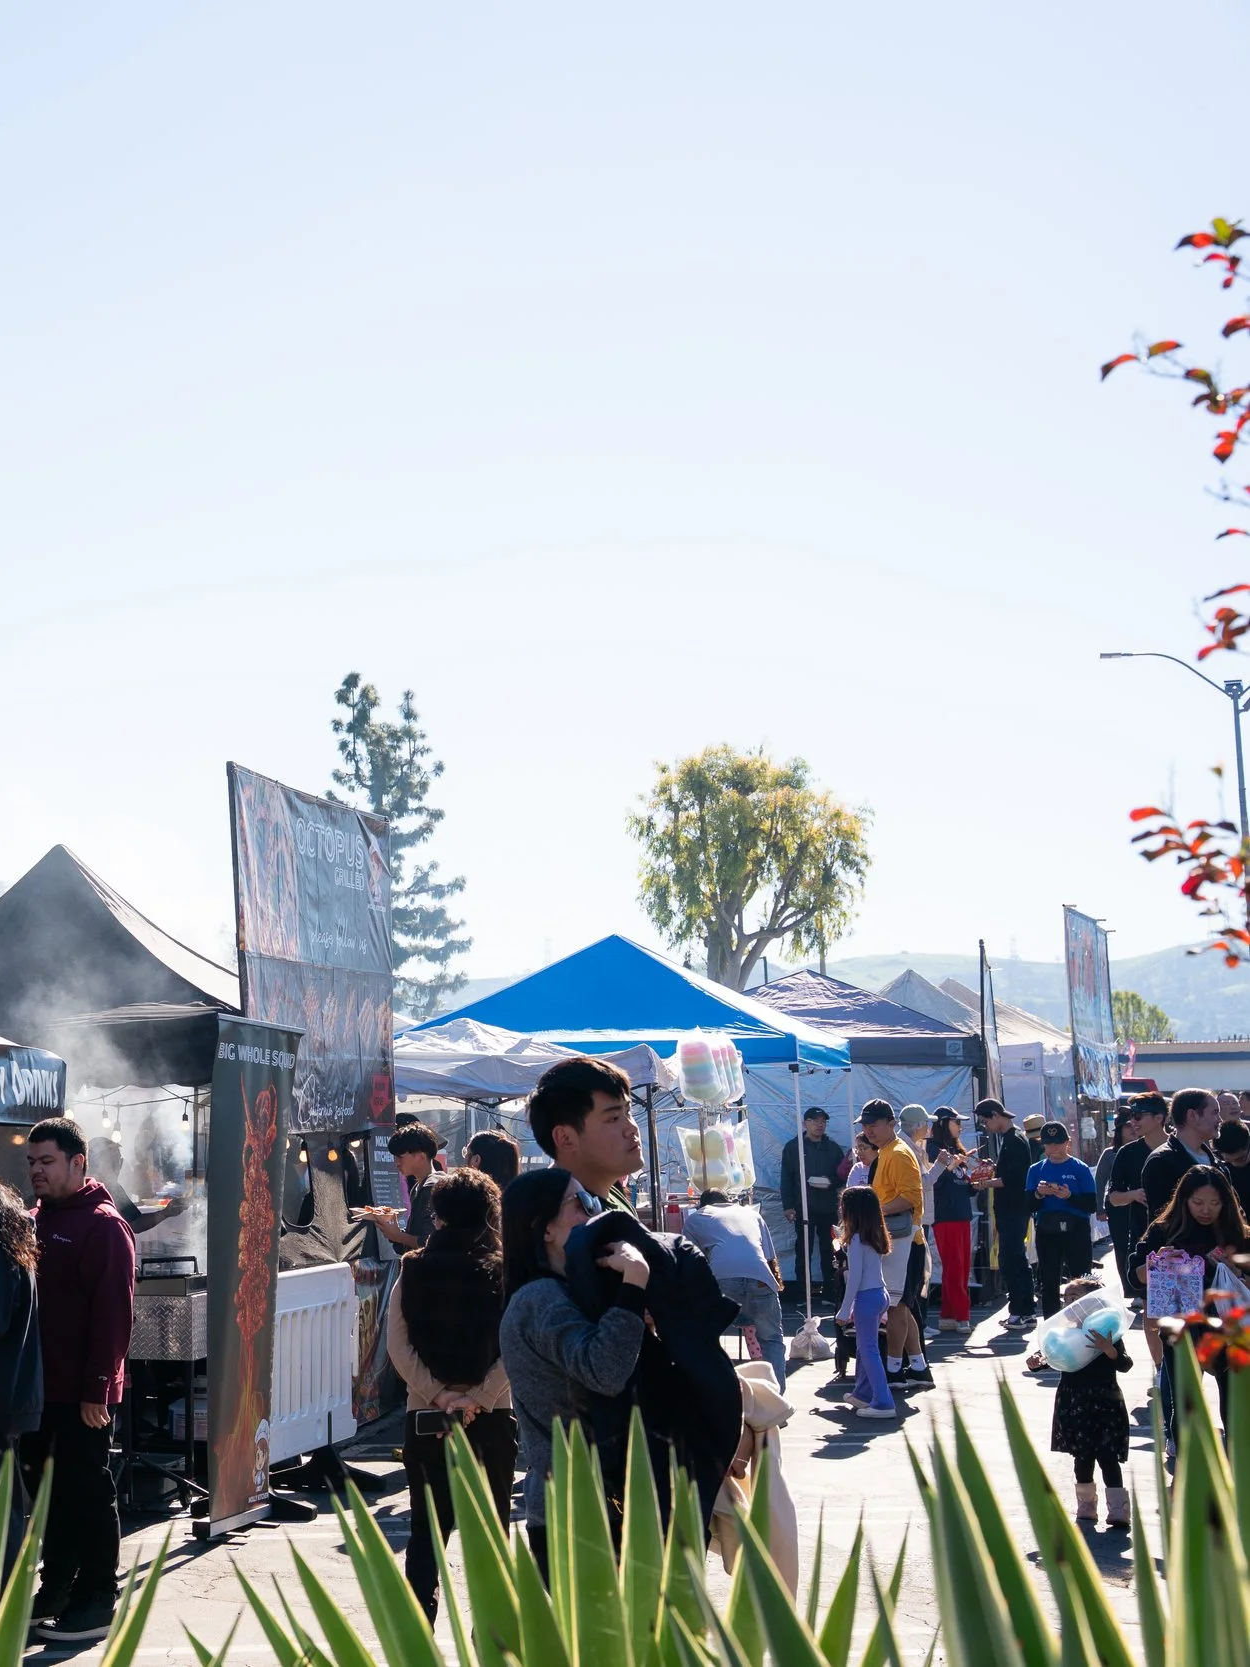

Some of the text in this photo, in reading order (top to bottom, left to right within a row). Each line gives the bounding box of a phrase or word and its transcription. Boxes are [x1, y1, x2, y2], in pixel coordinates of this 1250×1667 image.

[296, 819, 364, 870] OCTOPUS
[334, 866, 365, 892] GRILLED
[310, 917, 368, 956] please follow us
[217, 1042, 295, 1071] BIG WHOLE SQUID
[10, 1061, 58, 1110] DRINKS
[375, 1135, 391, 1148] MOLLY
[374, 1150, 395, 1163] KITCHEN
